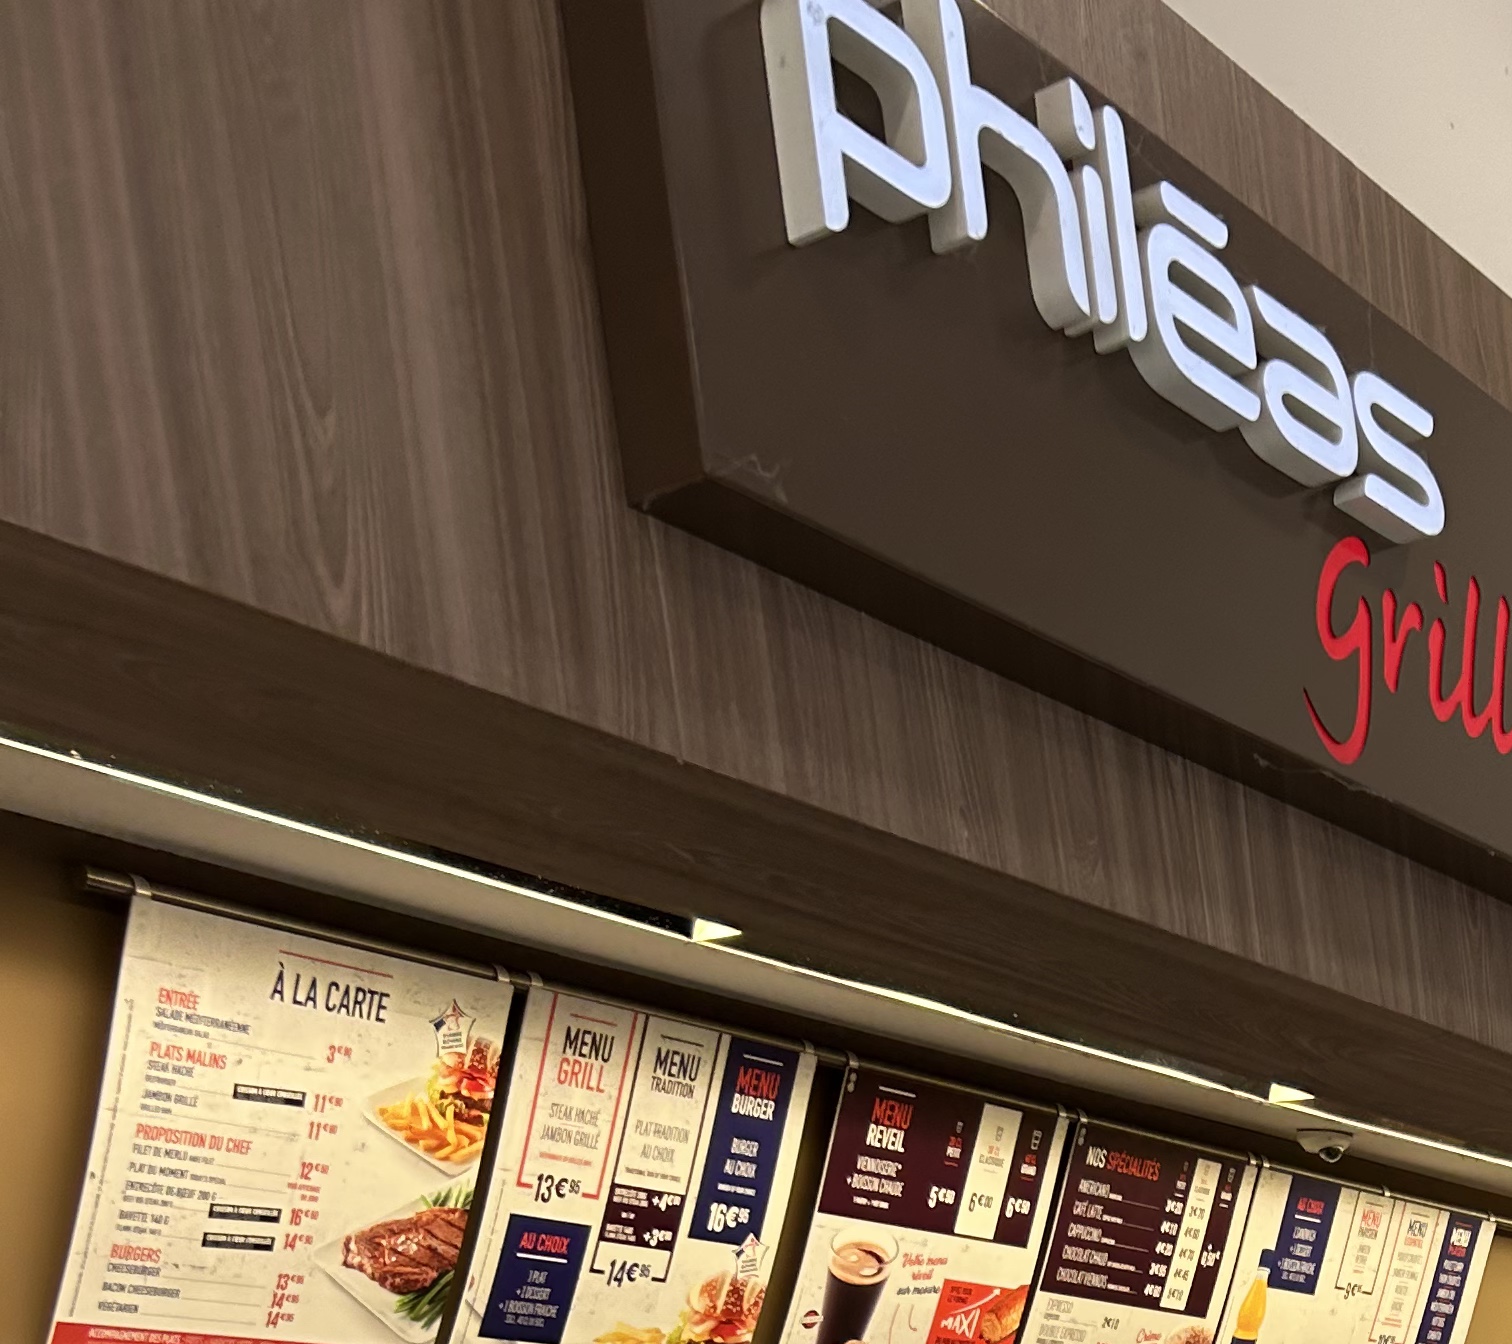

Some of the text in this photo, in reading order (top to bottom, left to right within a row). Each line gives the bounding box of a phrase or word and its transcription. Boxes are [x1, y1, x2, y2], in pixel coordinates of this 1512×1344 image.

[158, 987, 200, 1011] ENTRÉE
[269, 961, 390, 1024] À LA CARTE
[150, 1041, 227, 1070] PLATS MALINS
[563, 1025, 616, 1063] MENU
[556, 1057, 606, 1094] GRILL
[653, 1046, 702, 1082] MENU
[650, 1075, 696, 1098] TRADITION
[736, 1065, 781, 1100] MENU
[549, 1102, 573, 1121] STEAK
[731, 1093, 776, 1121] BURGER
[870, 1096, 915, 1130] MENU
[136, 1123, 253, 1156] PROPOSITION DU CHEF
[540, 1123, 572, 1144] JAMBON
[1085, 1146, 1161, 1181] NOS SPÉCIALITÉS
[110, 1244, 163, 1264] BURGERS
[519, 1231, 571, 1254] AU CHOIX
